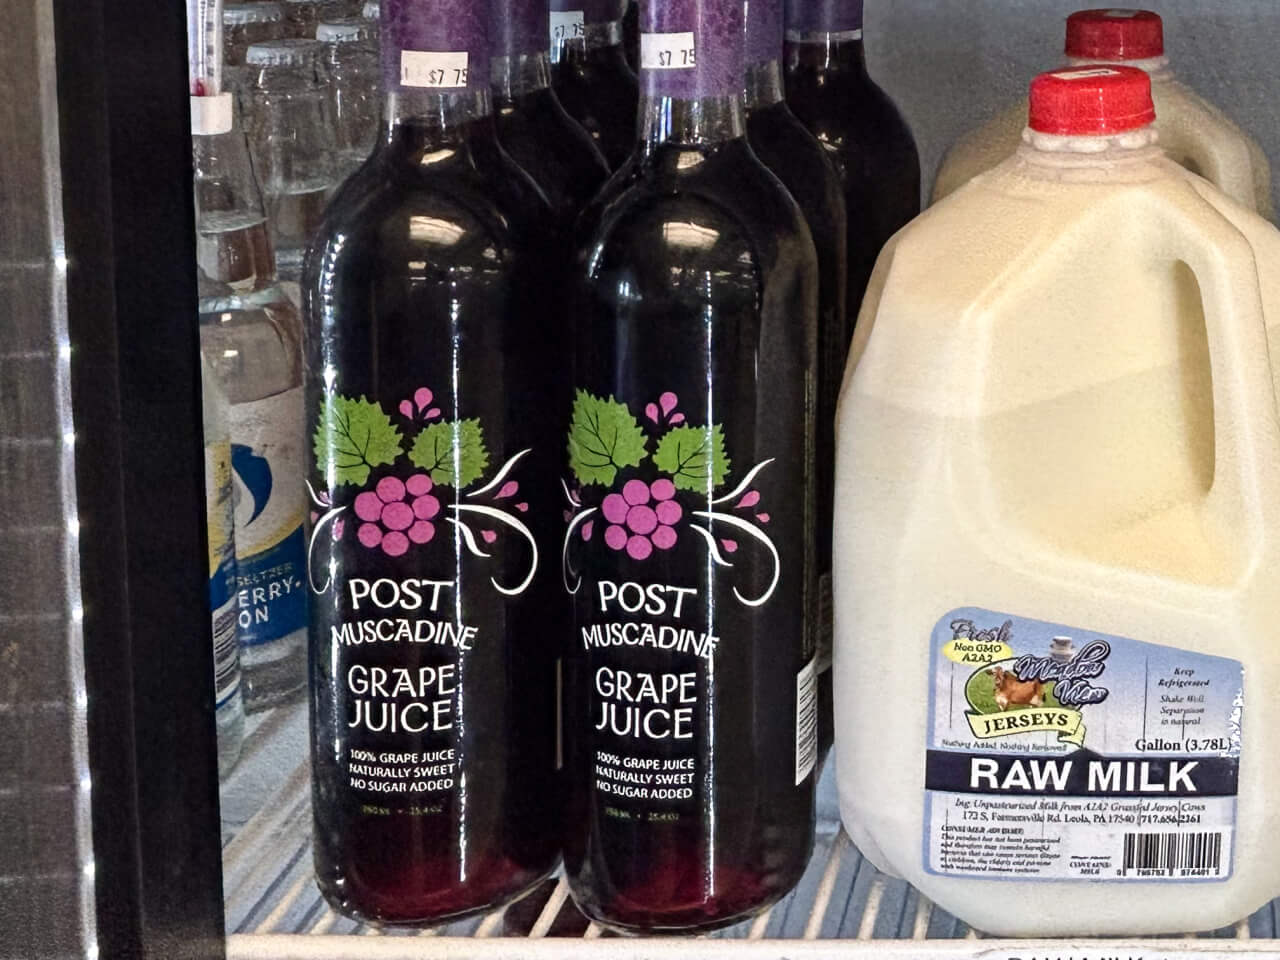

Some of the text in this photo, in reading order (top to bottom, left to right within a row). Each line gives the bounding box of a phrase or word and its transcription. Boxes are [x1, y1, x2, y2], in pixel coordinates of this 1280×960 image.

[348, 578, 454, 612] POST
[597, 580, 698, 619] POST
[331, 619, 478, 650] MUSCADINE
[581, 621, 720, 659] MUSCADINE
[954, 641, 1002, 652] Non GMO
[962, 652, 993, 663] A2A2
[348, 664, 456, 698] GRAPE
[595, 666, 698, 704] GRAPE
[348, 698, 453, 734] JUICE
[595, 701, 693, 739] JUICE
[983, 712, 1068, 734] JERSEYS
[1135, 737, 1232, 753] Gallon (3.78L)
[350, 748, 456, 764] 100% GRAPE JUICE
[596, 751, 695, 771] 100% GRAPE JUICE
[349, 763, 456, 778] NATURALLY SWEET
[596, 765, 695, 785] NATURALLY SWEET
[969, 757, 1199, 792] RAW MILK
[350, 777, 454, 793] NO SUGAR ADDED
[596, 780, 693, 799] NO SUGAR ADDED
[1059, 800, 1082, 813] from
[1092, 813, 1106, 824] PA
